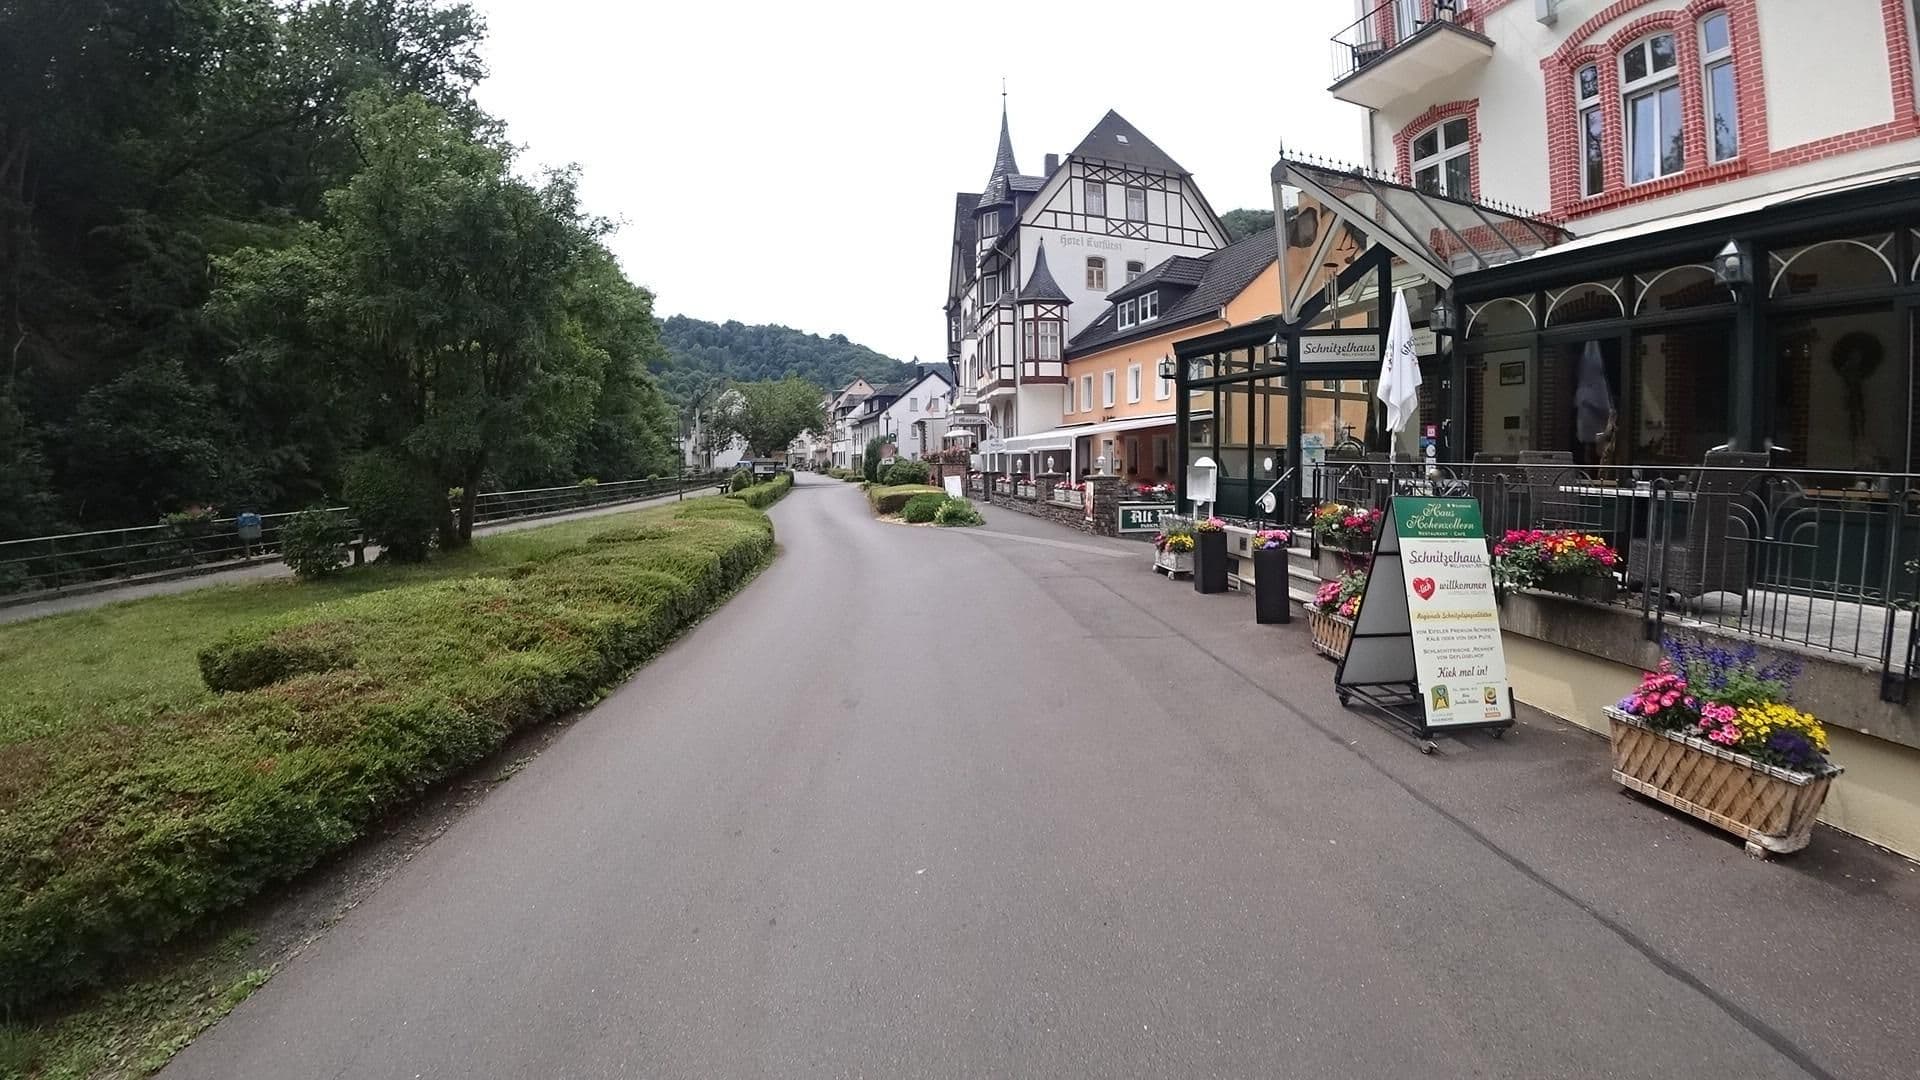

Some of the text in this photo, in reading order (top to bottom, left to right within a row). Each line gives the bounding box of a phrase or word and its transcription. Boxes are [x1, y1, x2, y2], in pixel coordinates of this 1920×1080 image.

[1060, 234, 1084, 247] Hotel
[1304, 342, 1376, 355] Schnitzelhaus
[1130, 510, 1153, 523] Alt
[1422, 503, 1455, 517] Haus
[1406, 514, 1474, 530] Hohenzollern
[1409, 550, 1482, 566] Schnitzelhaus
[1439, 580, 1487, 590] willkommen
